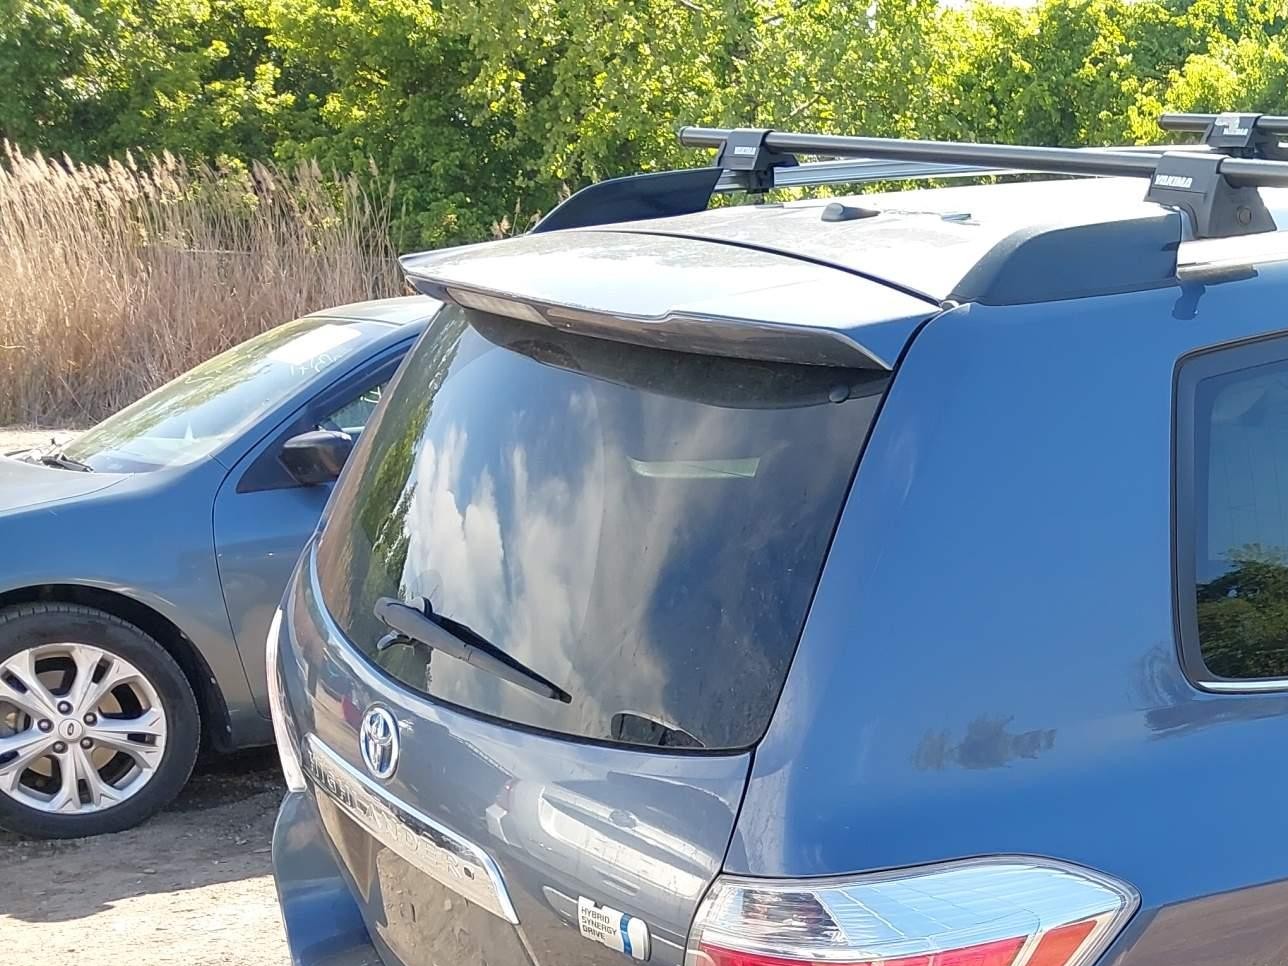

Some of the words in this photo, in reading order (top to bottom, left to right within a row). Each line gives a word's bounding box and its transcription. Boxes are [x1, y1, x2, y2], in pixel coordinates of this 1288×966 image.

[1154, 174, 1193, 188] YAKIMA
[308, 750, 464, 879] HIGHLANDER
[581, 906, 610, 924] HYBRID
[582, 916, 617, 936] SYNERGY
[582, 925, 606, 940] DRIVE
